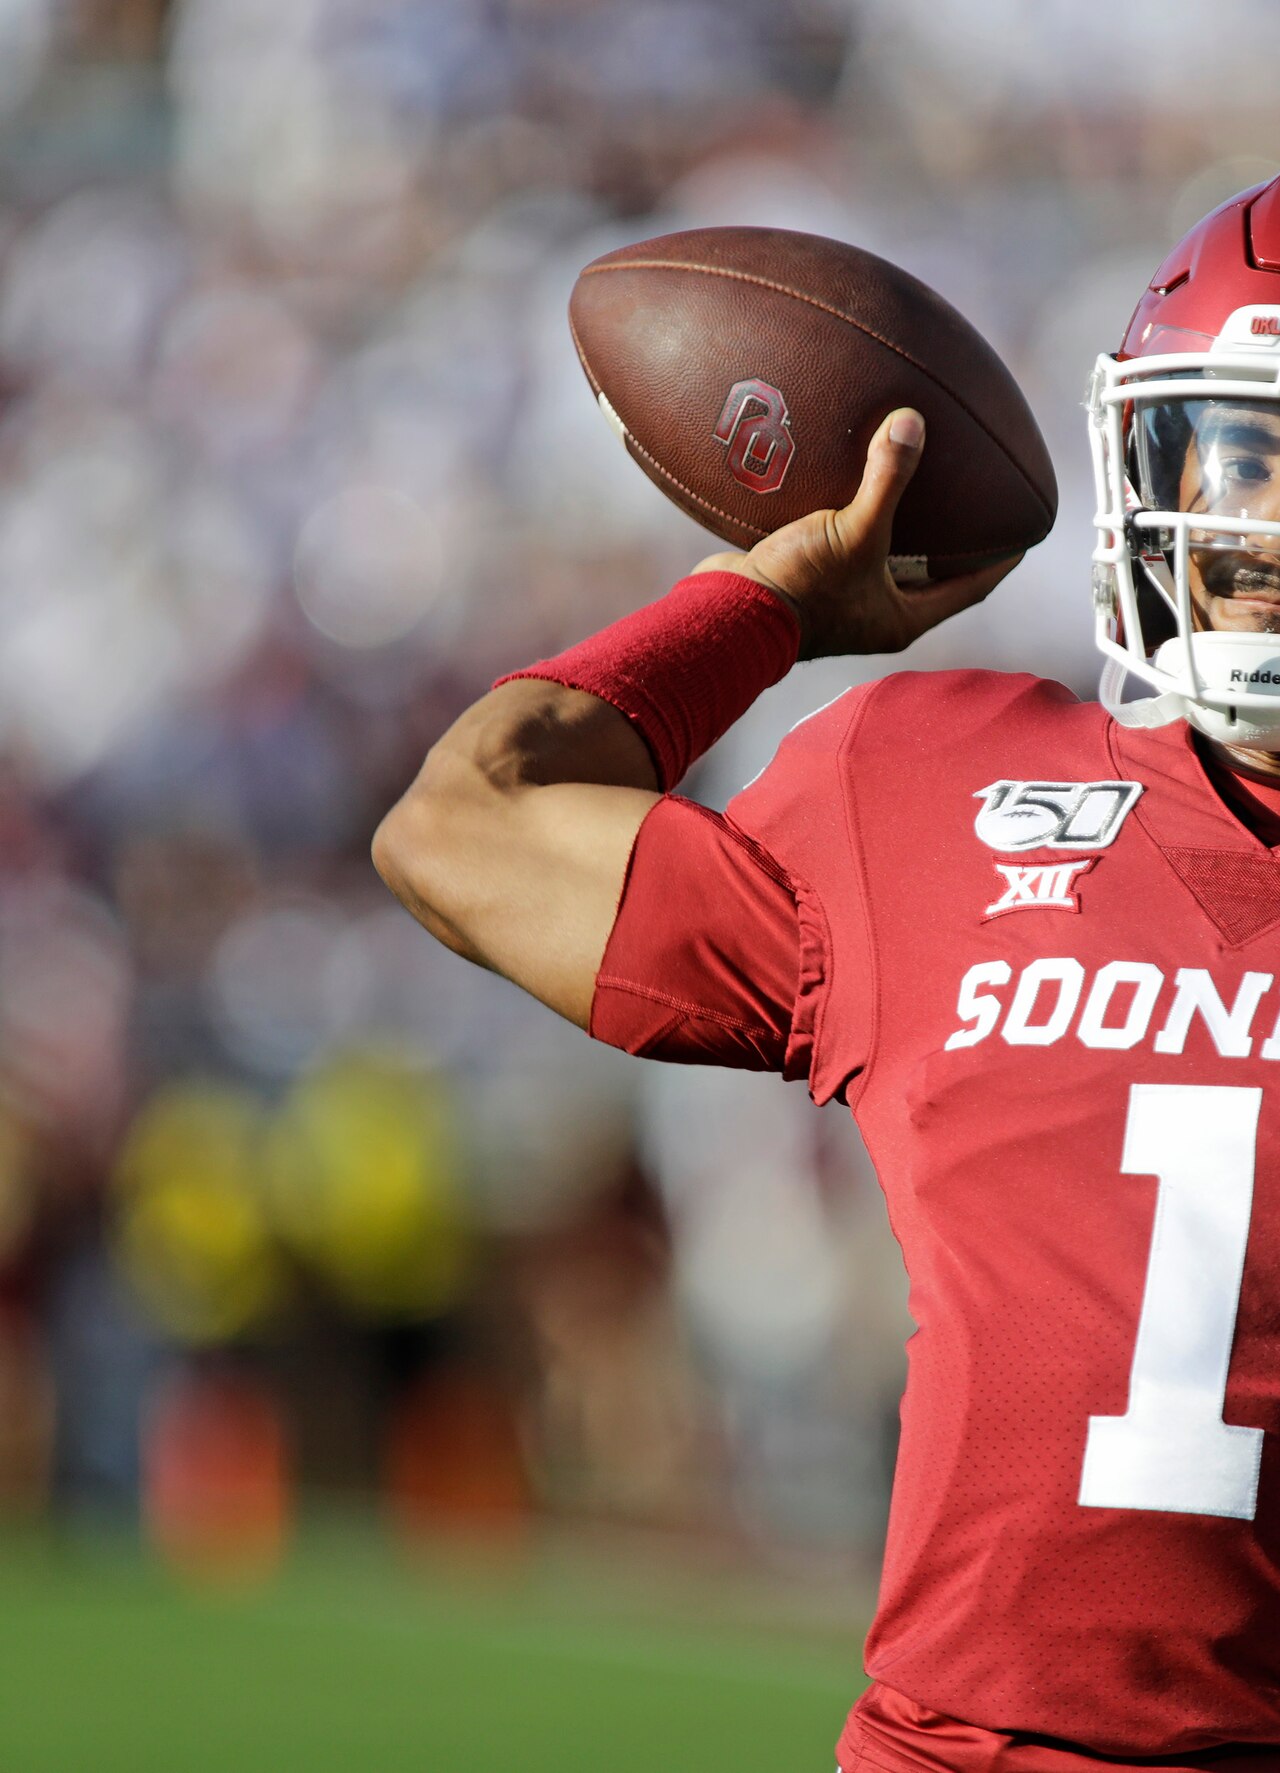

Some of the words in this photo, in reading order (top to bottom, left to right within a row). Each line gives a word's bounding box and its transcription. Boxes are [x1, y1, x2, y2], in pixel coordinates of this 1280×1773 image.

[972, 780, 1144, 852] 150
[985, 859, 1091, 915] XII
[1077, 1083, 1265, 1520] 1
